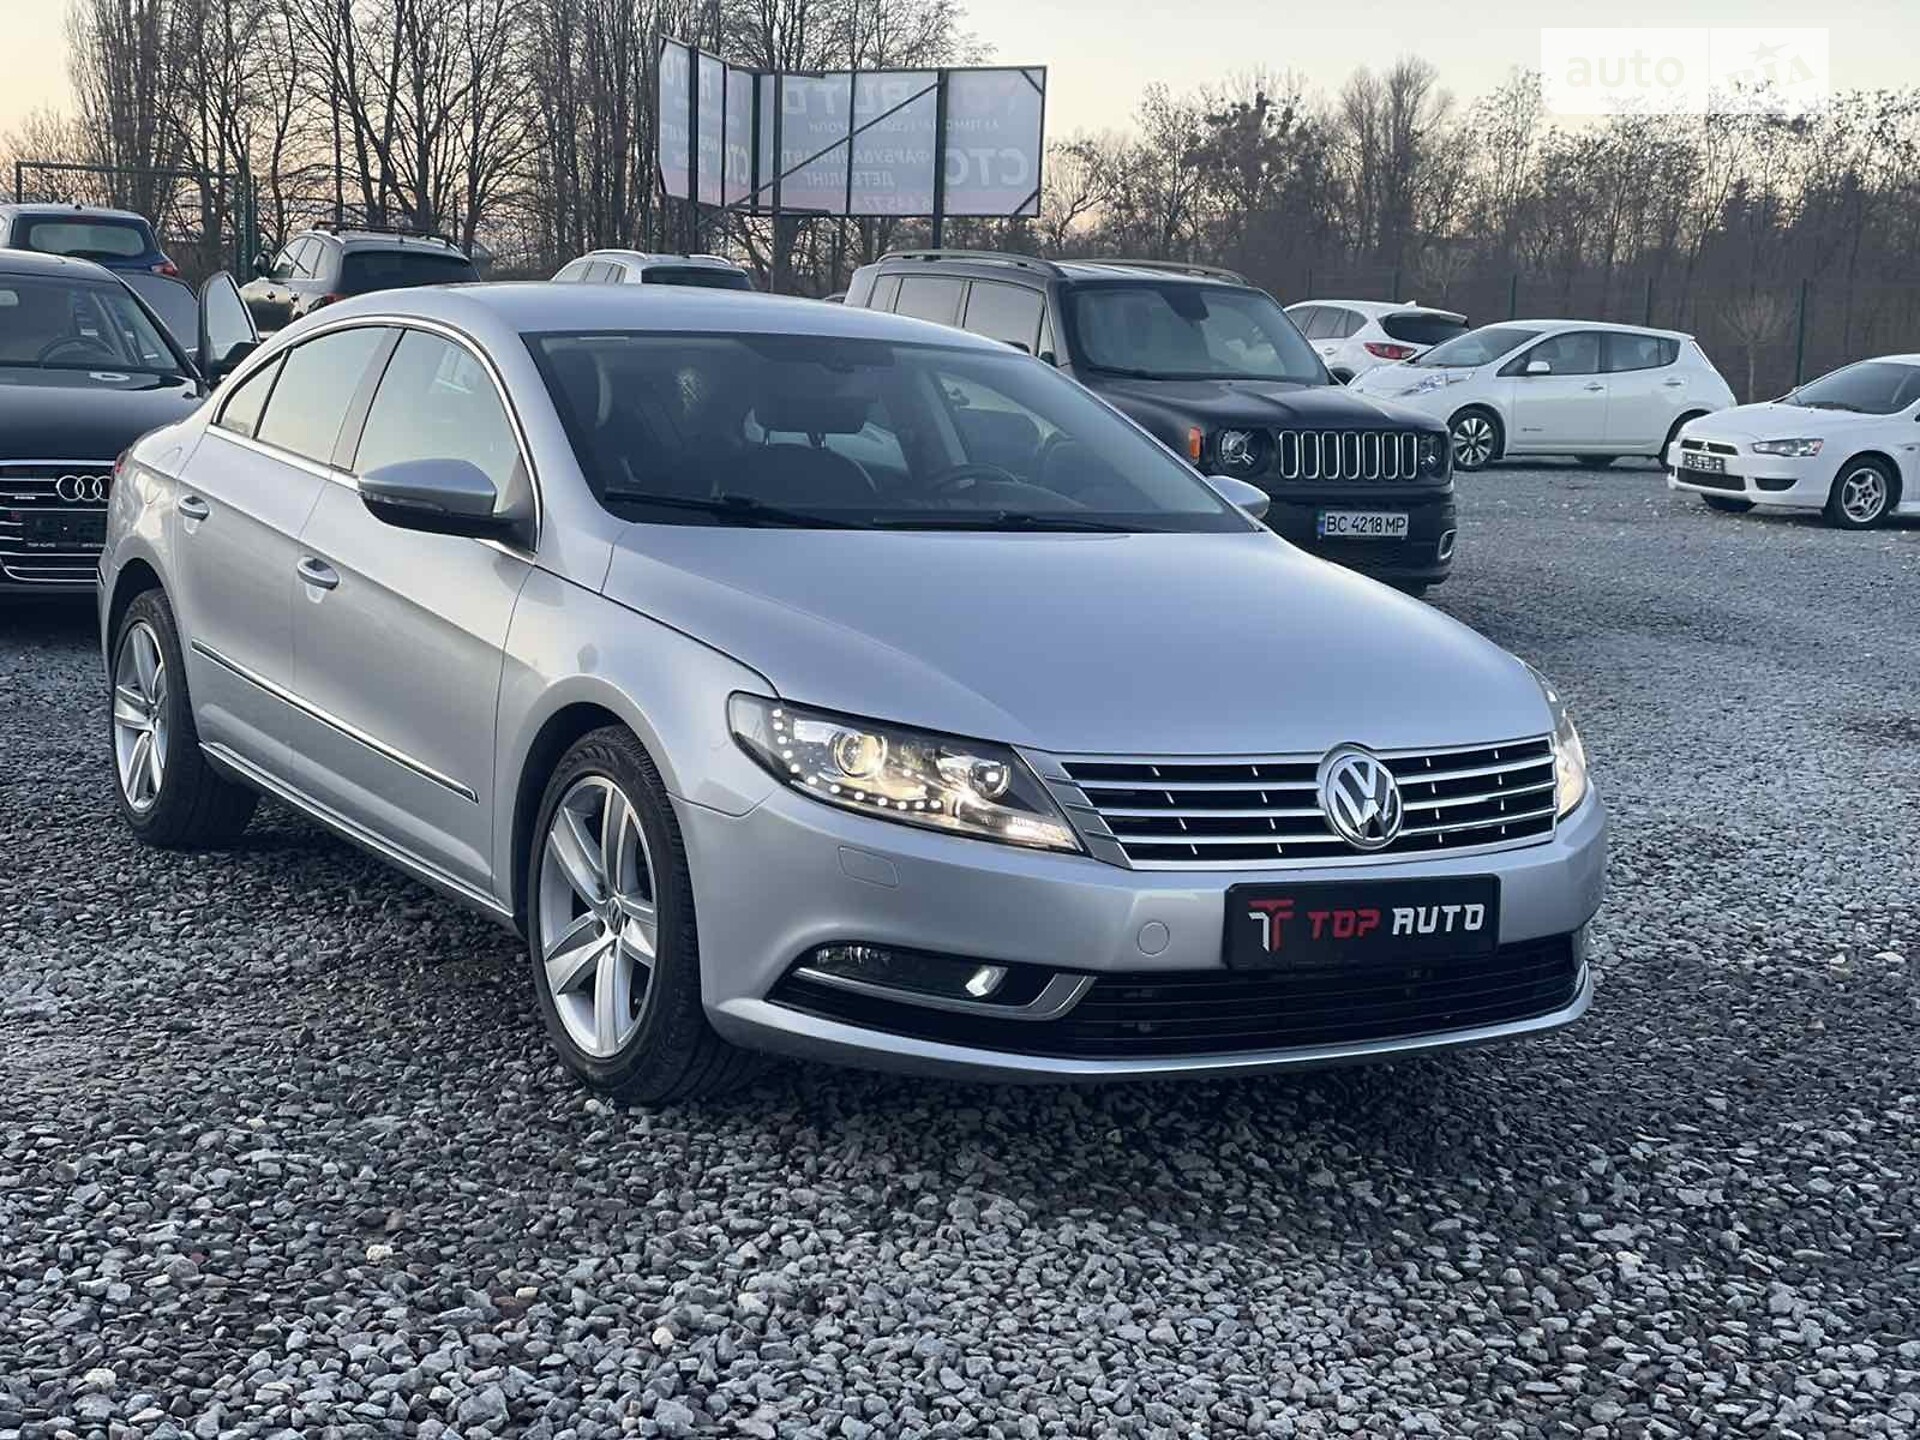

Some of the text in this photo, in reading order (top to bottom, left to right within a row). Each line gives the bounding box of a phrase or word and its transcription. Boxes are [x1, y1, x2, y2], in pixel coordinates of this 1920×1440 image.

[1325, 515, 1406, 534] BC 4218 MP
[1307, 903, 1485, 940] TOP AUTO
